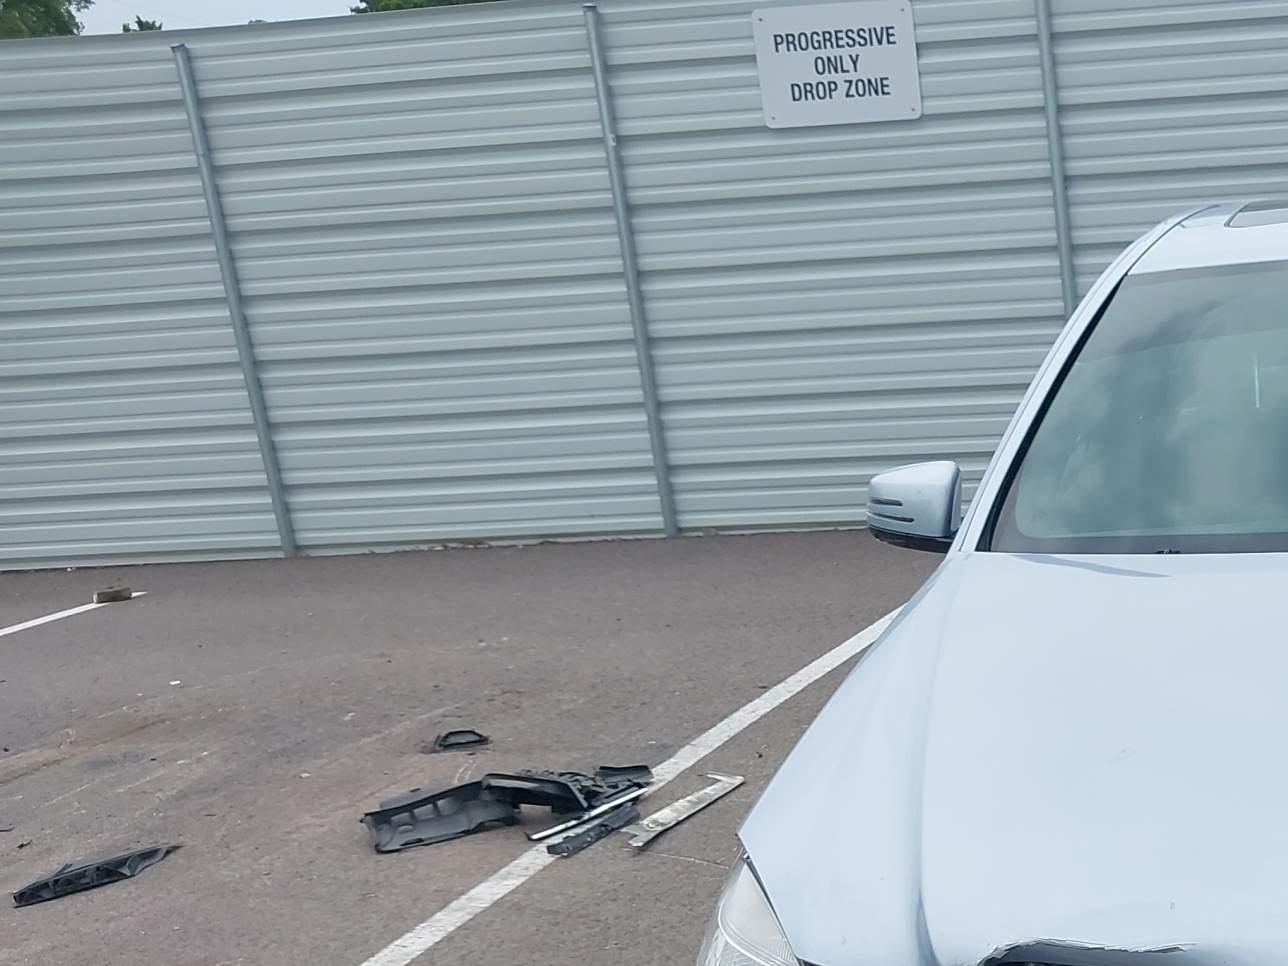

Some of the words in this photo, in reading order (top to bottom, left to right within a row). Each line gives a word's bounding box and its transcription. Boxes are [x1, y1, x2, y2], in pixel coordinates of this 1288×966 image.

[773, 26, 897, 53] PROGRESSIVE
[814, 54, 860, 75] ONLY
[790, 81, 838, 102] DROP
[844, 77, 891, 98] ZONE
